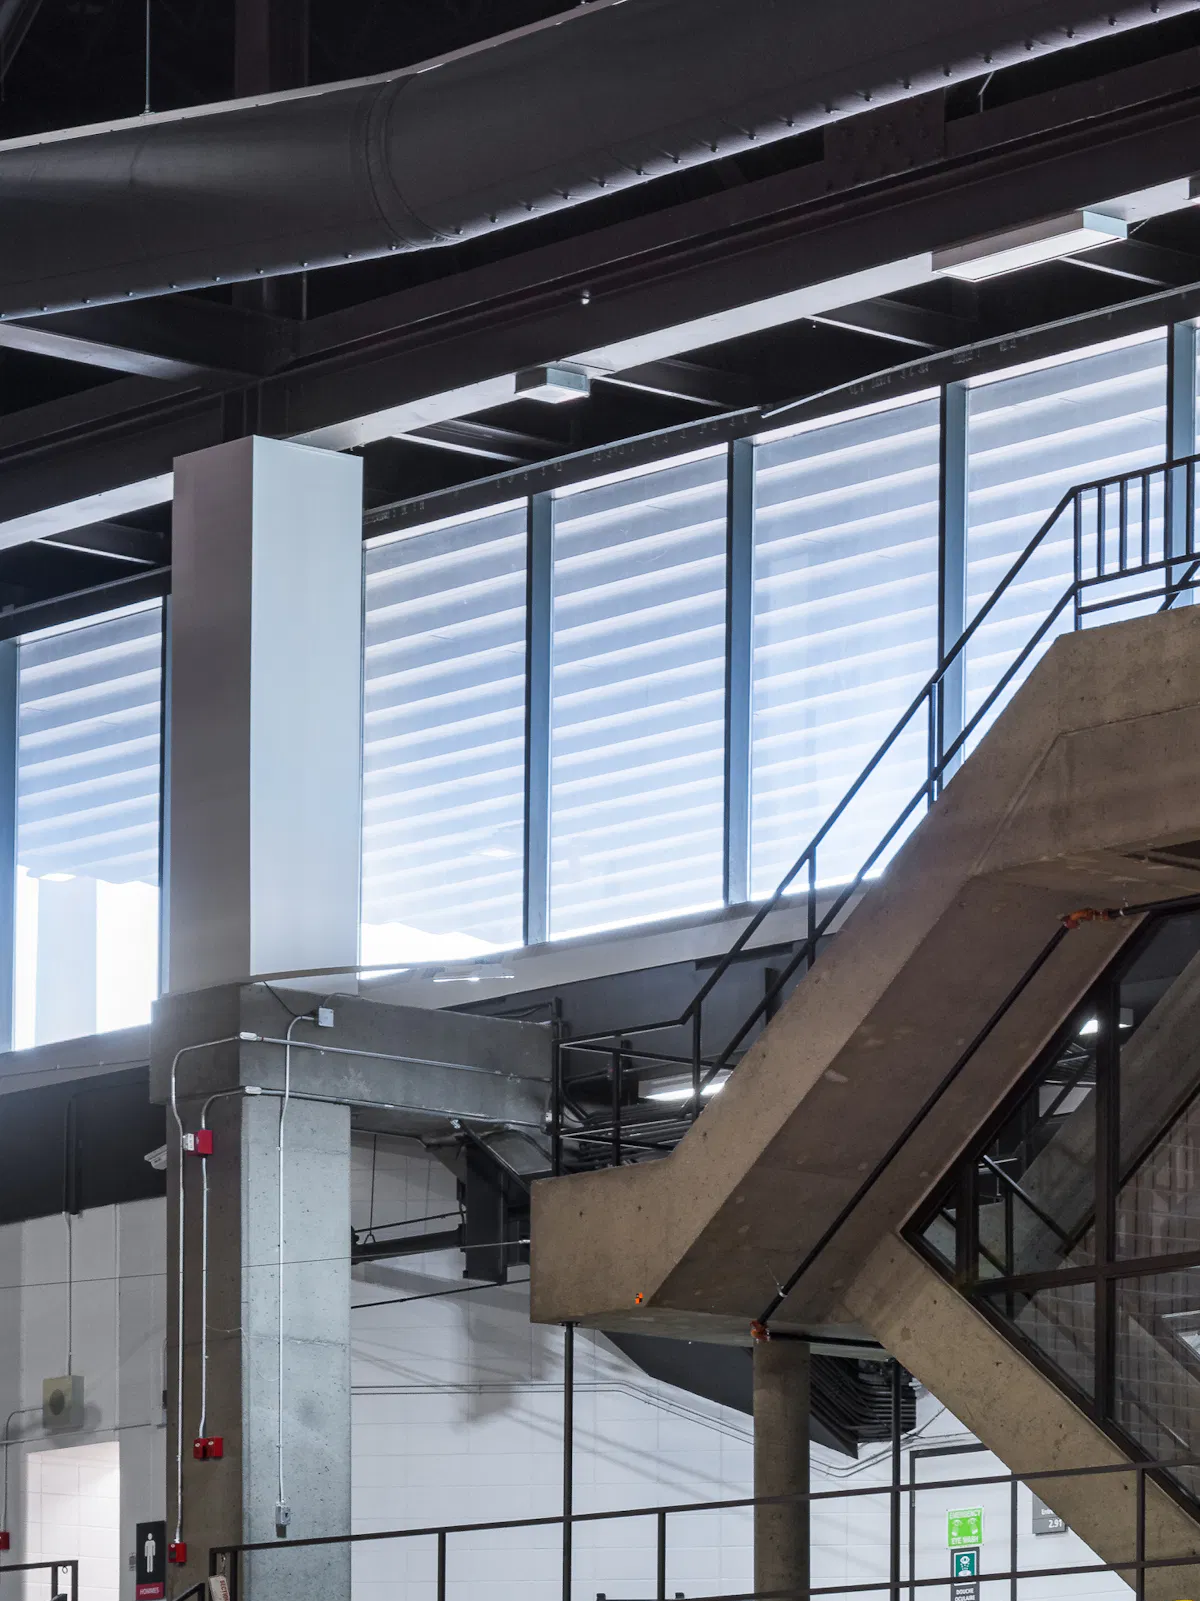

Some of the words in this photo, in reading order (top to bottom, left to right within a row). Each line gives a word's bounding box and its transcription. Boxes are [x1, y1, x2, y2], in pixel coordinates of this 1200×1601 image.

[949, 1509, 981, 1520] EMERGENCY
[1048, 1519, 1062, 1528] 2.91
[951, 1536, 962, 1544] EYE
[963, 1535, 979, 1543] WASH
[140, 1586, 160, 1596] HOMMES
[220, 1580, 228, 1601] SECTION
[954, 1594, 976, 1601] OCULAIRE
